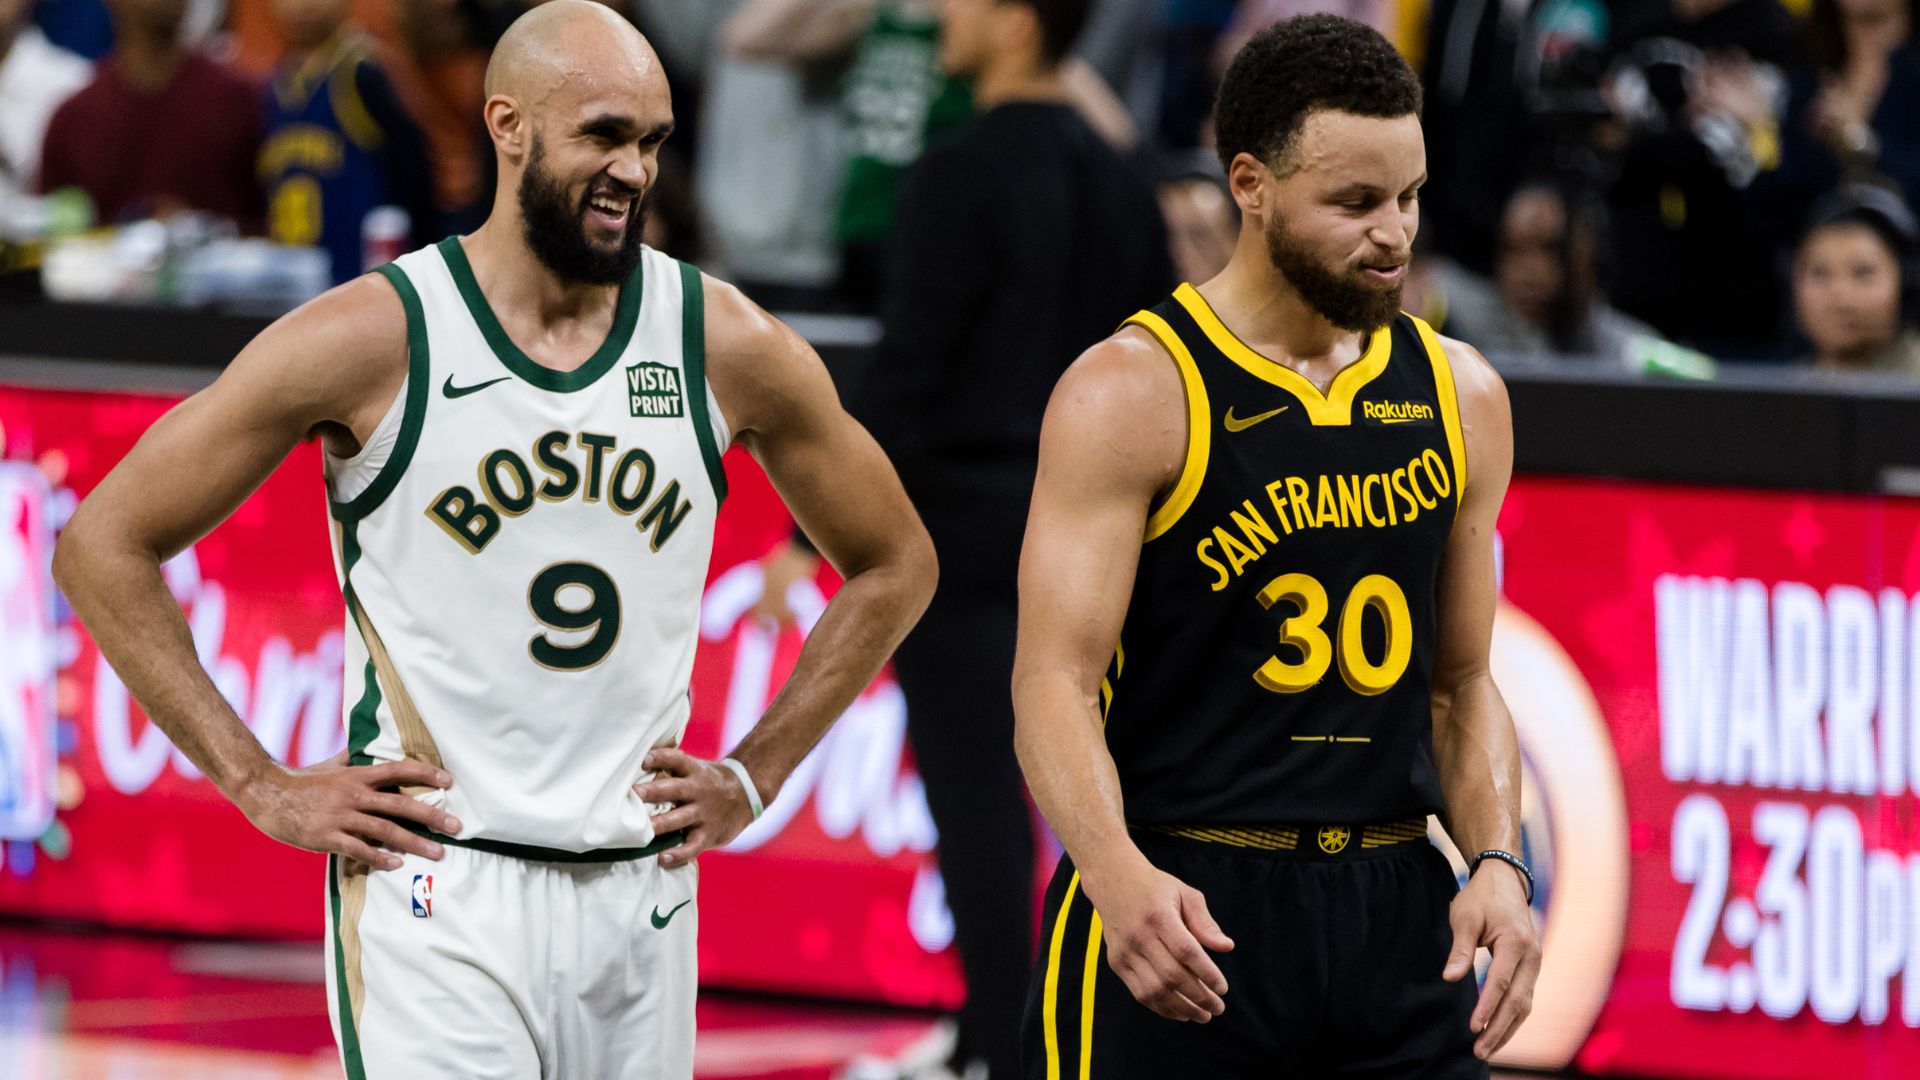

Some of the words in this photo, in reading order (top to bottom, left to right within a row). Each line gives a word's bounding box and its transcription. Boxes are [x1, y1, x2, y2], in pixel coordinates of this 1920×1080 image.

[628, 367, 679, 394] VISTA
[631, 395, 680, 415] PRINT
[1363, 400, 1434, 420] Rakuten
[424, 430, 692, 556] BOSTON
[1197, 499, 1279, 592] SAN
[1265, 448, 1451, 535] FRANCISCO
[526, 560, 622, 672] 9
[1252, 572, 1413, 696] 30
[1654, 573, 1920, 797] WARRI
